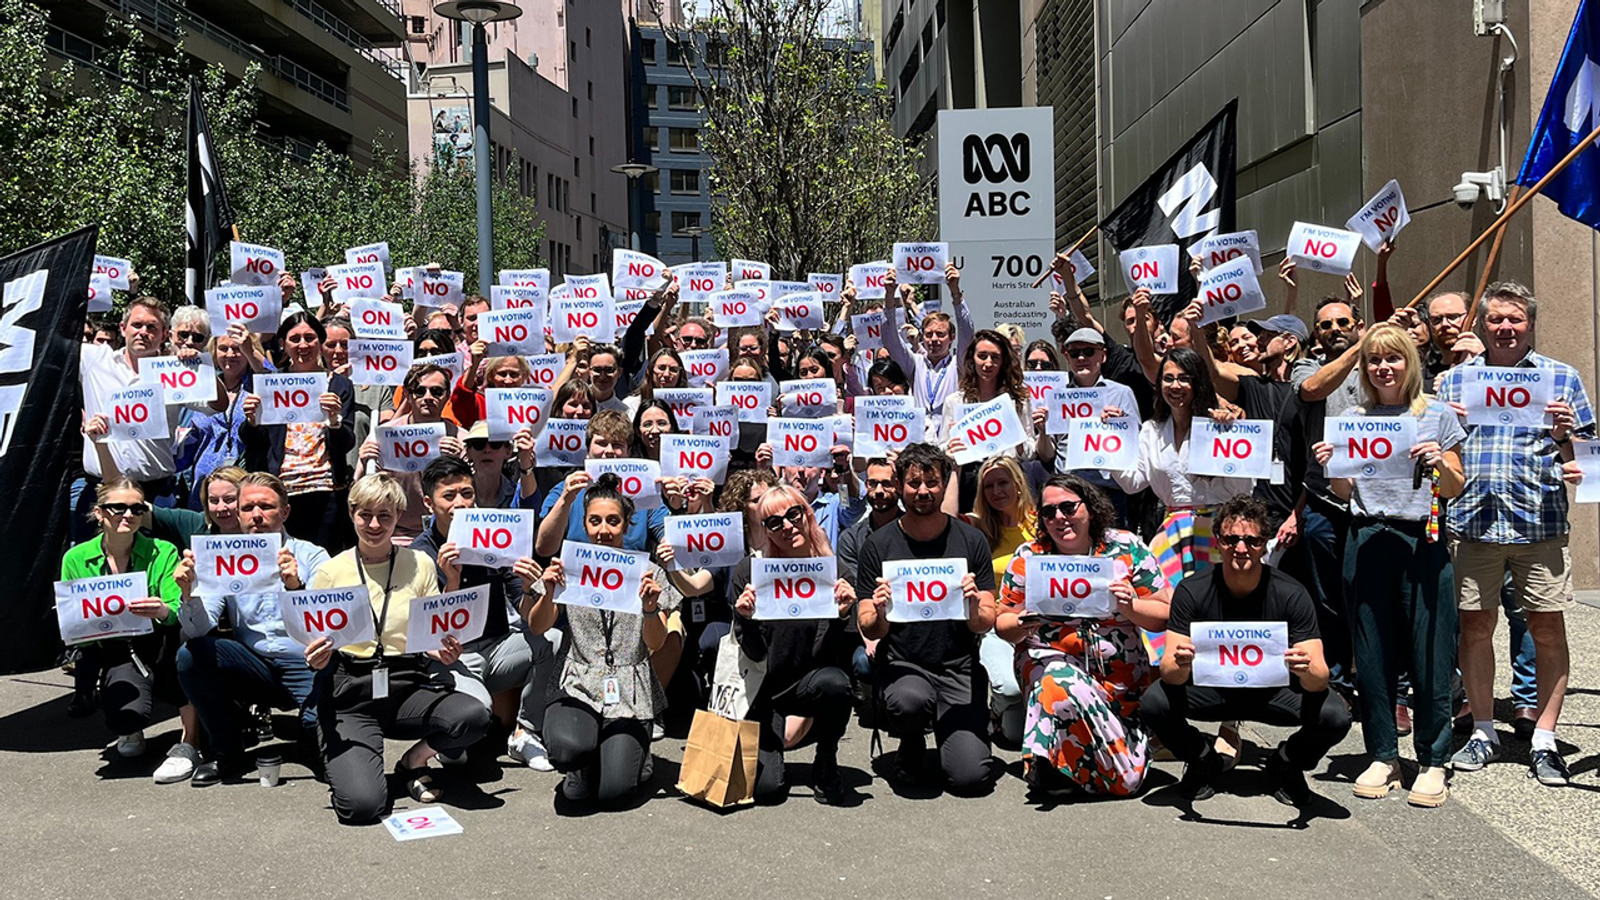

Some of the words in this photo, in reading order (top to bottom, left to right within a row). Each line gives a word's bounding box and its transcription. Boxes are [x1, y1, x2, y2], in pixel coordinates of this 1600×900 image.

[964, 191, 1031, 218] ABC
[1374, 206, 1398, 232] NO
[1303, 227, 1317, 235] I'M
[1217, 237, 1248, 246] VOTING
[1304, 240, 1337, 258] NO
[252, 248, 279, 258] VOTING
[247, 257, 273, 275] NO
[629, 263, 654, 277] NO
[907, 256, 934, 271] NO
[992, 255, 1042, 278] 700
[346, 275, 372, 289] NO
[742, 270, 762, 279] NO
[1212, 269, 1243, 283] VOTING
[424, 282, 448, 296] NO
[575, 287, 596, 298] NO
[691, 280, 713, 291] NO
[816, 283, 833, 292] NO
[217, 292, 229, 300] I'M
[230, 290, 263, 299] VOTING
[1207, 284, 1242, 307] NO
[225, 302, 258, 320] NO
[723, 302, 746, 315] NO
[786, 305, 808, 318] NO
[994, 310, 1047, 319] Broadcasting
[488, 315, 501, 323] I'M
[502, 312, 532, 321] VOTING
[568, 312, 597, 328] NO
[495, 325, 527, 342] NO
[372, 343, 403, 351] VOTING
[366, 356, 397, 371] NO
[692, 362, 715, 376] NO
[160, 371, 196, 388] NO
[265, 378, 279, 386] I'M
[282, 376, 316, 385] VOTING
[1478, 372, 1493, 380] I'M
[1496, 373, 1541, 382] VOTING
[122, 389, 153, 399] VOTING
[274, 390, 309, 408] NO
[515, 393, 545, 401] VOTING
[797, 392, 822, 406] NO
[1068, 391, 1098, 399] VOTING
[1486, 387, 1530, 408] NO
[115, 403, 148, 423] NO
[508, 405, 540, 424] NO
[867, 411, 878, 419] I'M
[881, 411, 914, 420] VOTING
[969, 402, 1001, 422] VOTING
[1062, 403, 1092, 419] NO
[385, 430, 398, 438] I'M
[401, 428, 434, 436] VOTING
[710, 420, 731, 436] NO
[874, 424, 907, 442] NO
[967, 419, 1002, 445] NO
[1096, 422, 1128, 430] VOTING
[1222, 425, 1261, 434] VOTING
[1339, 422, 1356, 431] I'M
[1358, 422, 1401, 431] VOTING
[395, 440, 429, 458] NO
[550, 435, 580, 452] NO
[687, 439, 720, 448] VOTING
[786, 434, 816, 452] NO
[1084, 434, 1121, 453] NO
[1213, 438, 1252, 459] NO
[1349, 437, 1392, 459] NO
[613, 463, 648, 471] VOTING
[680, 451, 713, 469] NO
[465, 514, 479, 522] I'M
[482, 514, 520, 523] VOTING
[677, 521, 691, 529] I'M
[693, 518, 731, 527] VOTING
[207, 540, 222, 549] I'M
[224, 539, 267, 549] VOTING
[472, 528, 512, 549] NO
[687, 532, 724, 552] NO
[576, 548, 592, 559] I'M
[594, 551, 635, 565] VOTING
[216, 555, 258, 576] NO
[764, 564, 779, 572] I'M
[783, 563, 823, 572] VOTING
[898, 567, 912, 575] I'M
[916, 566, 954, 574] VOTING
[1041, 563, 1056, 571] I'M
[1059, 563, 1099, 572] VOTING
[580, 565, 623, 590] NO
[71, 583, 86, 593] I'M
[89, 579, 132, 591] VOTING
[774, 577, 816, 599] NO
[906, 581, 947, 602] NO
[1050, 578, 1091, 599] NO
[292, 596, 308, 606] I'M
[311, 592, 354, 604] VOTING
[424, 601, 438, 610] I'M
[440, 592, 478, 607] VOTING
[82, 595, 126, 619] NO
[304, 609, 348, 632] NO
[432, 609, 469, 634] NO
[1209, 630, 1224, 638] I'M
[1227, 630, 1271, 638] VOTING
[1219, 644, 1263, 666] NO
